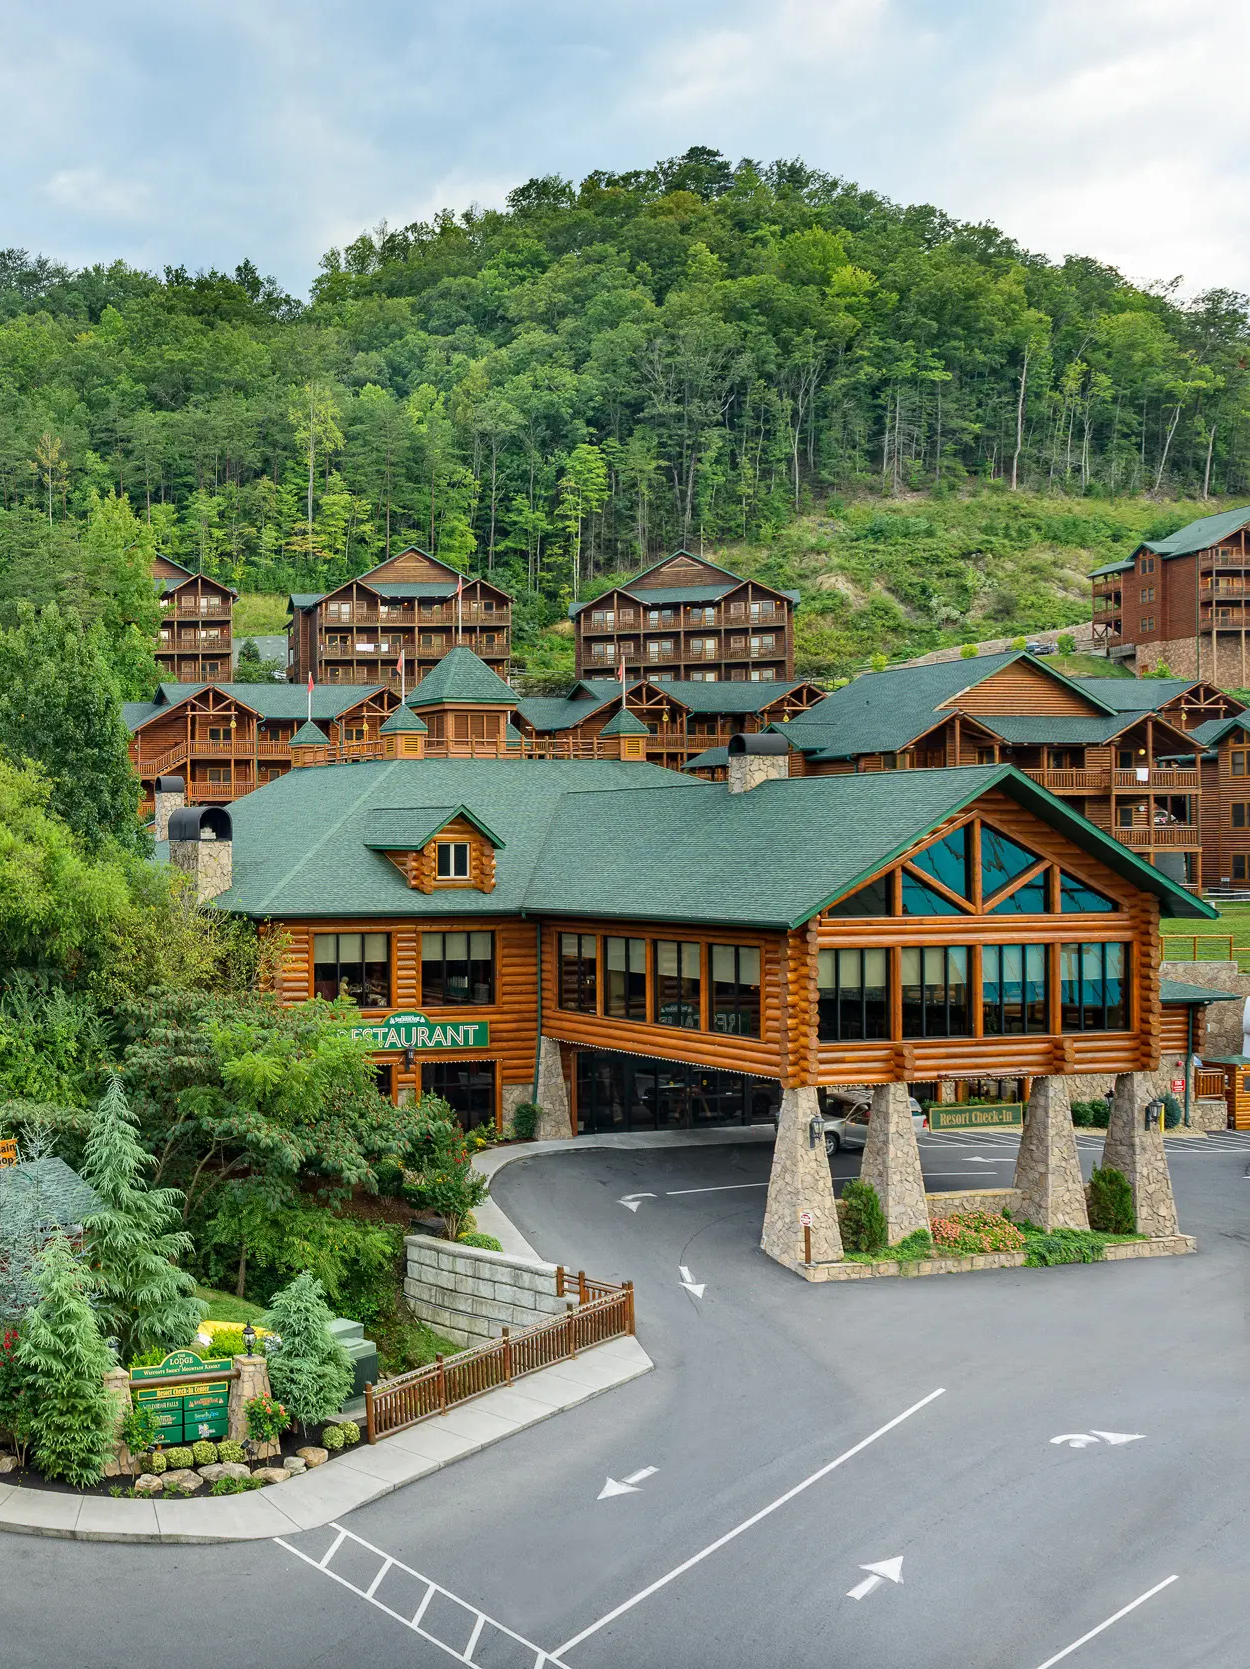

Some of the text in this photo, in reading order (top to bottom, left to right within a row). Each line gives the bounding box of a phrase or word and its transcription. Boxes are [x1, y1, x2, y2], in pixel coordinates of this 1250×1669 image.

[338, 1025, 479, 1048] ESTAURANT
[940, 1109, 1013, 1126] Resort Check-In
[170, 1357, 193, 1365] LODGE
[157, 1385, 210, 1397] Resort Check-In Center
